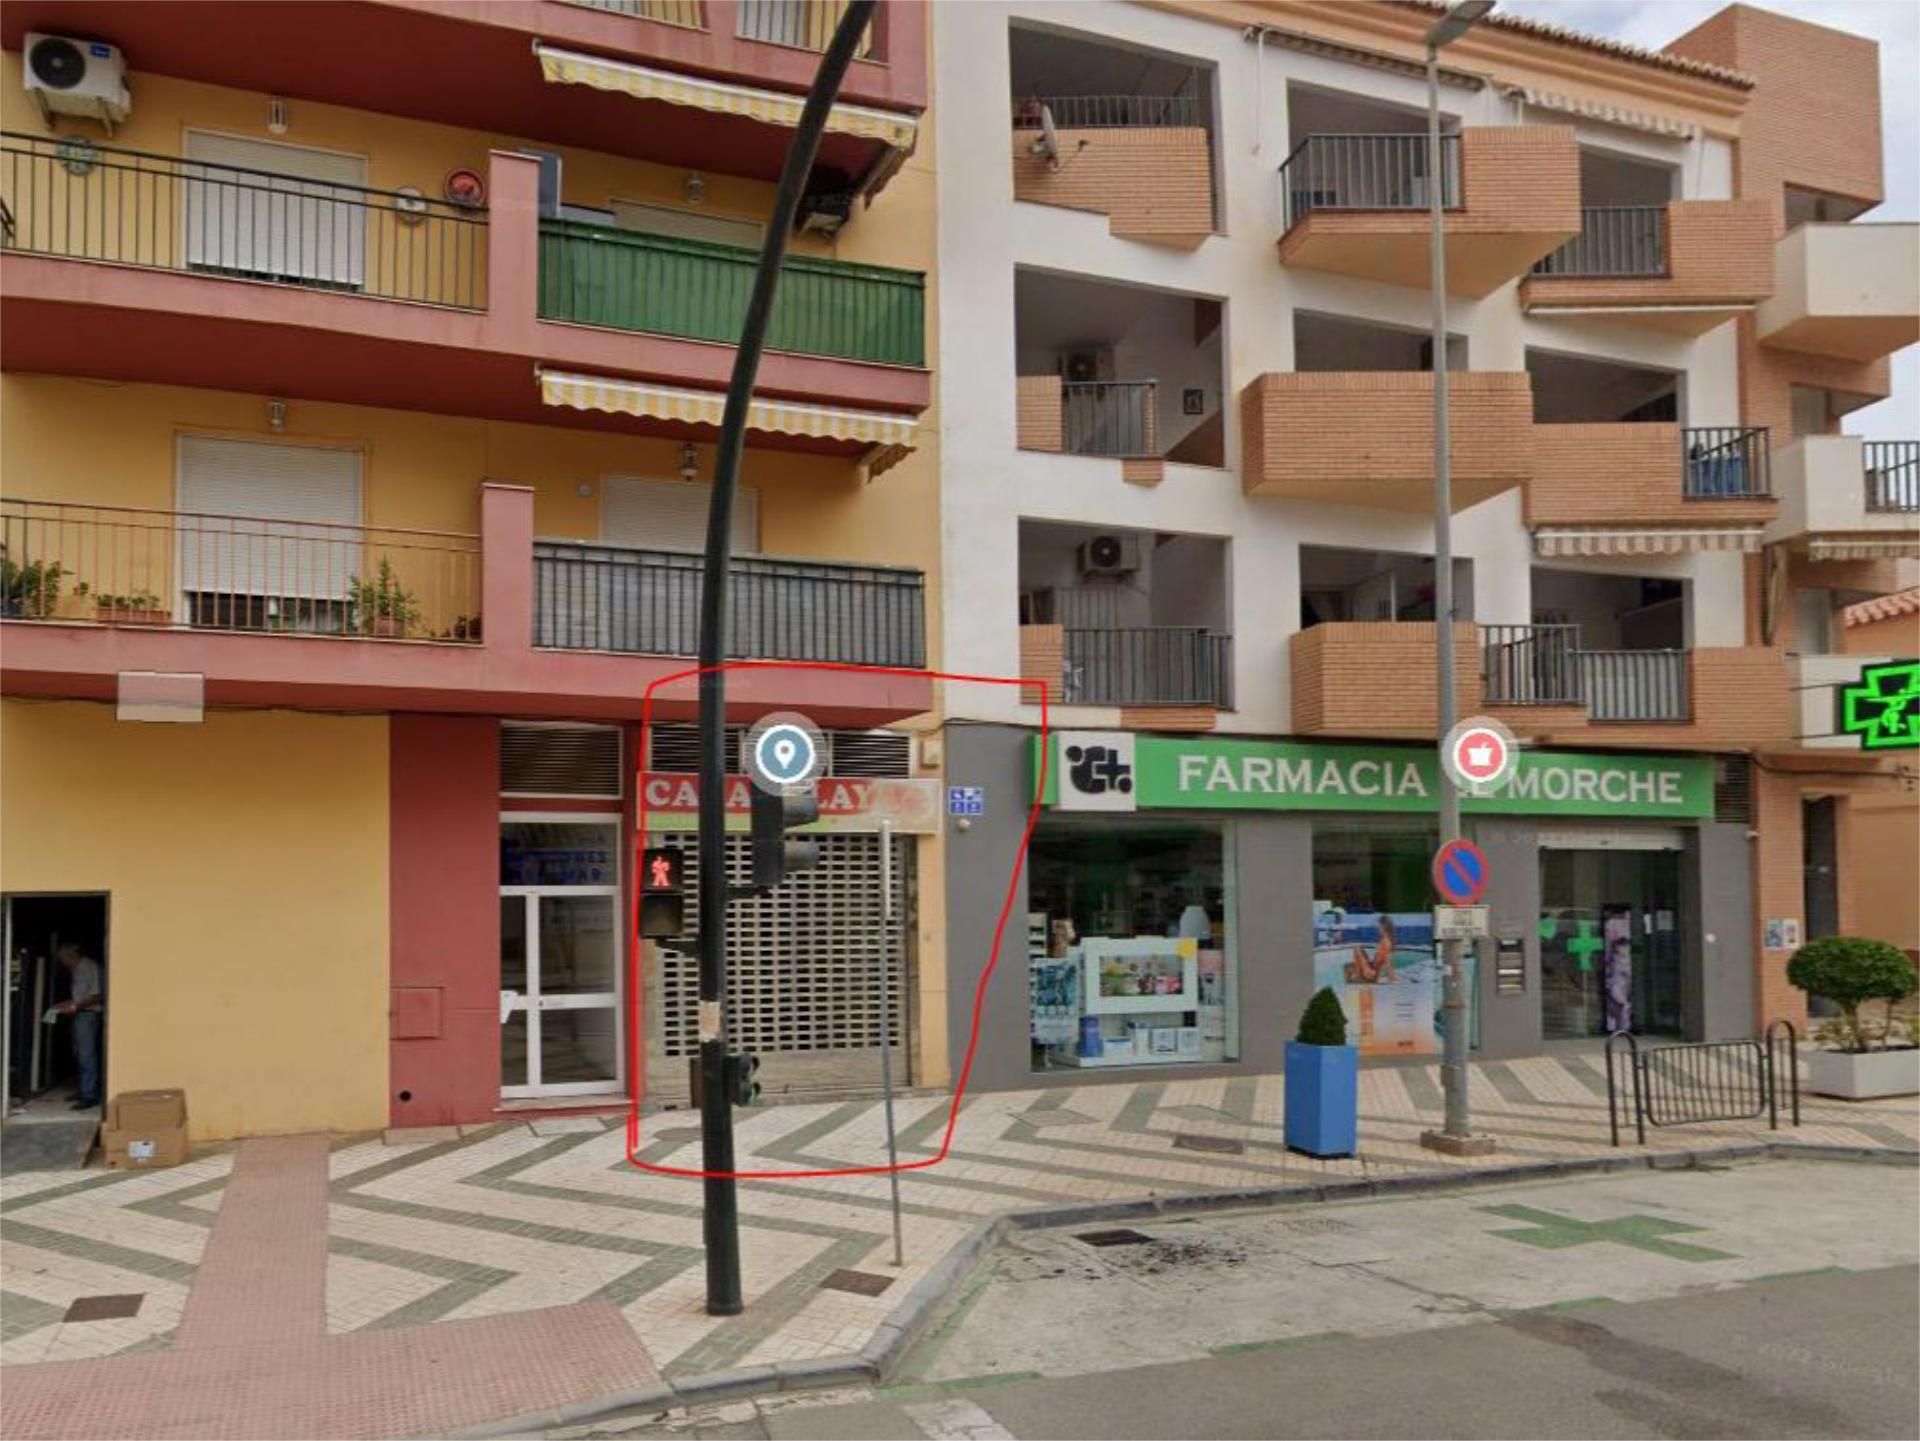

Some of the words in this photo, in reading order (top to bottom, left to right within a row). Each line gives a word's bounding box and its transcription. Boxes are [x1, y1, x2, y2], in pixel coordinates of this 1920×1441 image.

[645, 778, 752, 808] CAA
[1177, 754, 1428, 797] FARMACIA
[1506, 767, 1683, 803] MORCHE
